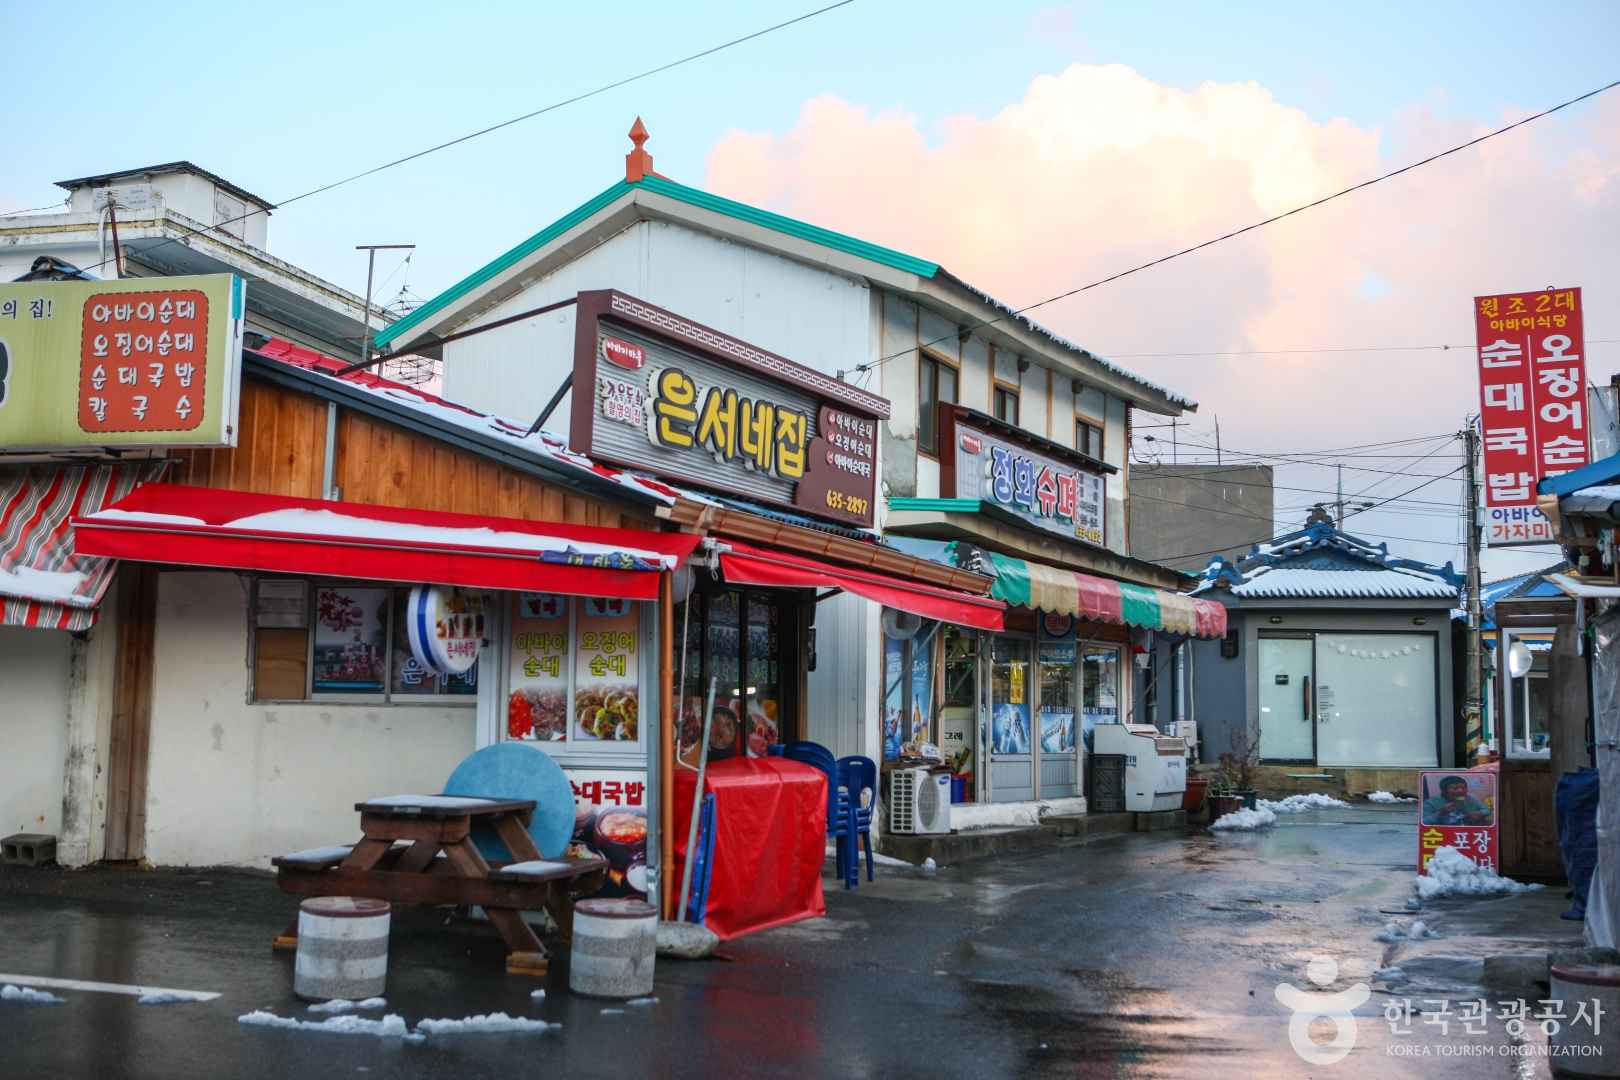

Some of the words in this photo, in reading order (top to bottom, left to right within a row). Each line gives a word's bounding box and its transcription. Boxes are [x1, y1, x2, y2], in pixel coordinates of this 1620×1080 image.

[29, 299, 53, 318] 집!
[92, 298, 196, 324] 아바이순대
[1481, 298, 1527, 316] 원조
[1536, 291, 1575, 312] 2대
[1490, 314, 1567, 332] 아바이식당
[93, 331, 194, 357] 오징어순대
[91, 362, 195, 390] 순대국밥
[88, 395, 193, 422] 칼국수
[1536, 334, 1585, 480] 오징어순
[656, 369, 807, 479] 은서네집
[836, 414, 873, 439] 아바이순대
[1481, 339, 1534, 502] 순대국밥
[834, 433, 872, 459] 오징어순대
[1492, 523, 1549, 541] 가자미
[517, 632, 568, 655] 아바이
[581, 632, 635, 654] 오징어
[524, 656, 560, 677] 순대
[590, 655, 626, 677] 순대
[1455, 831, 1492, 853] 포장
